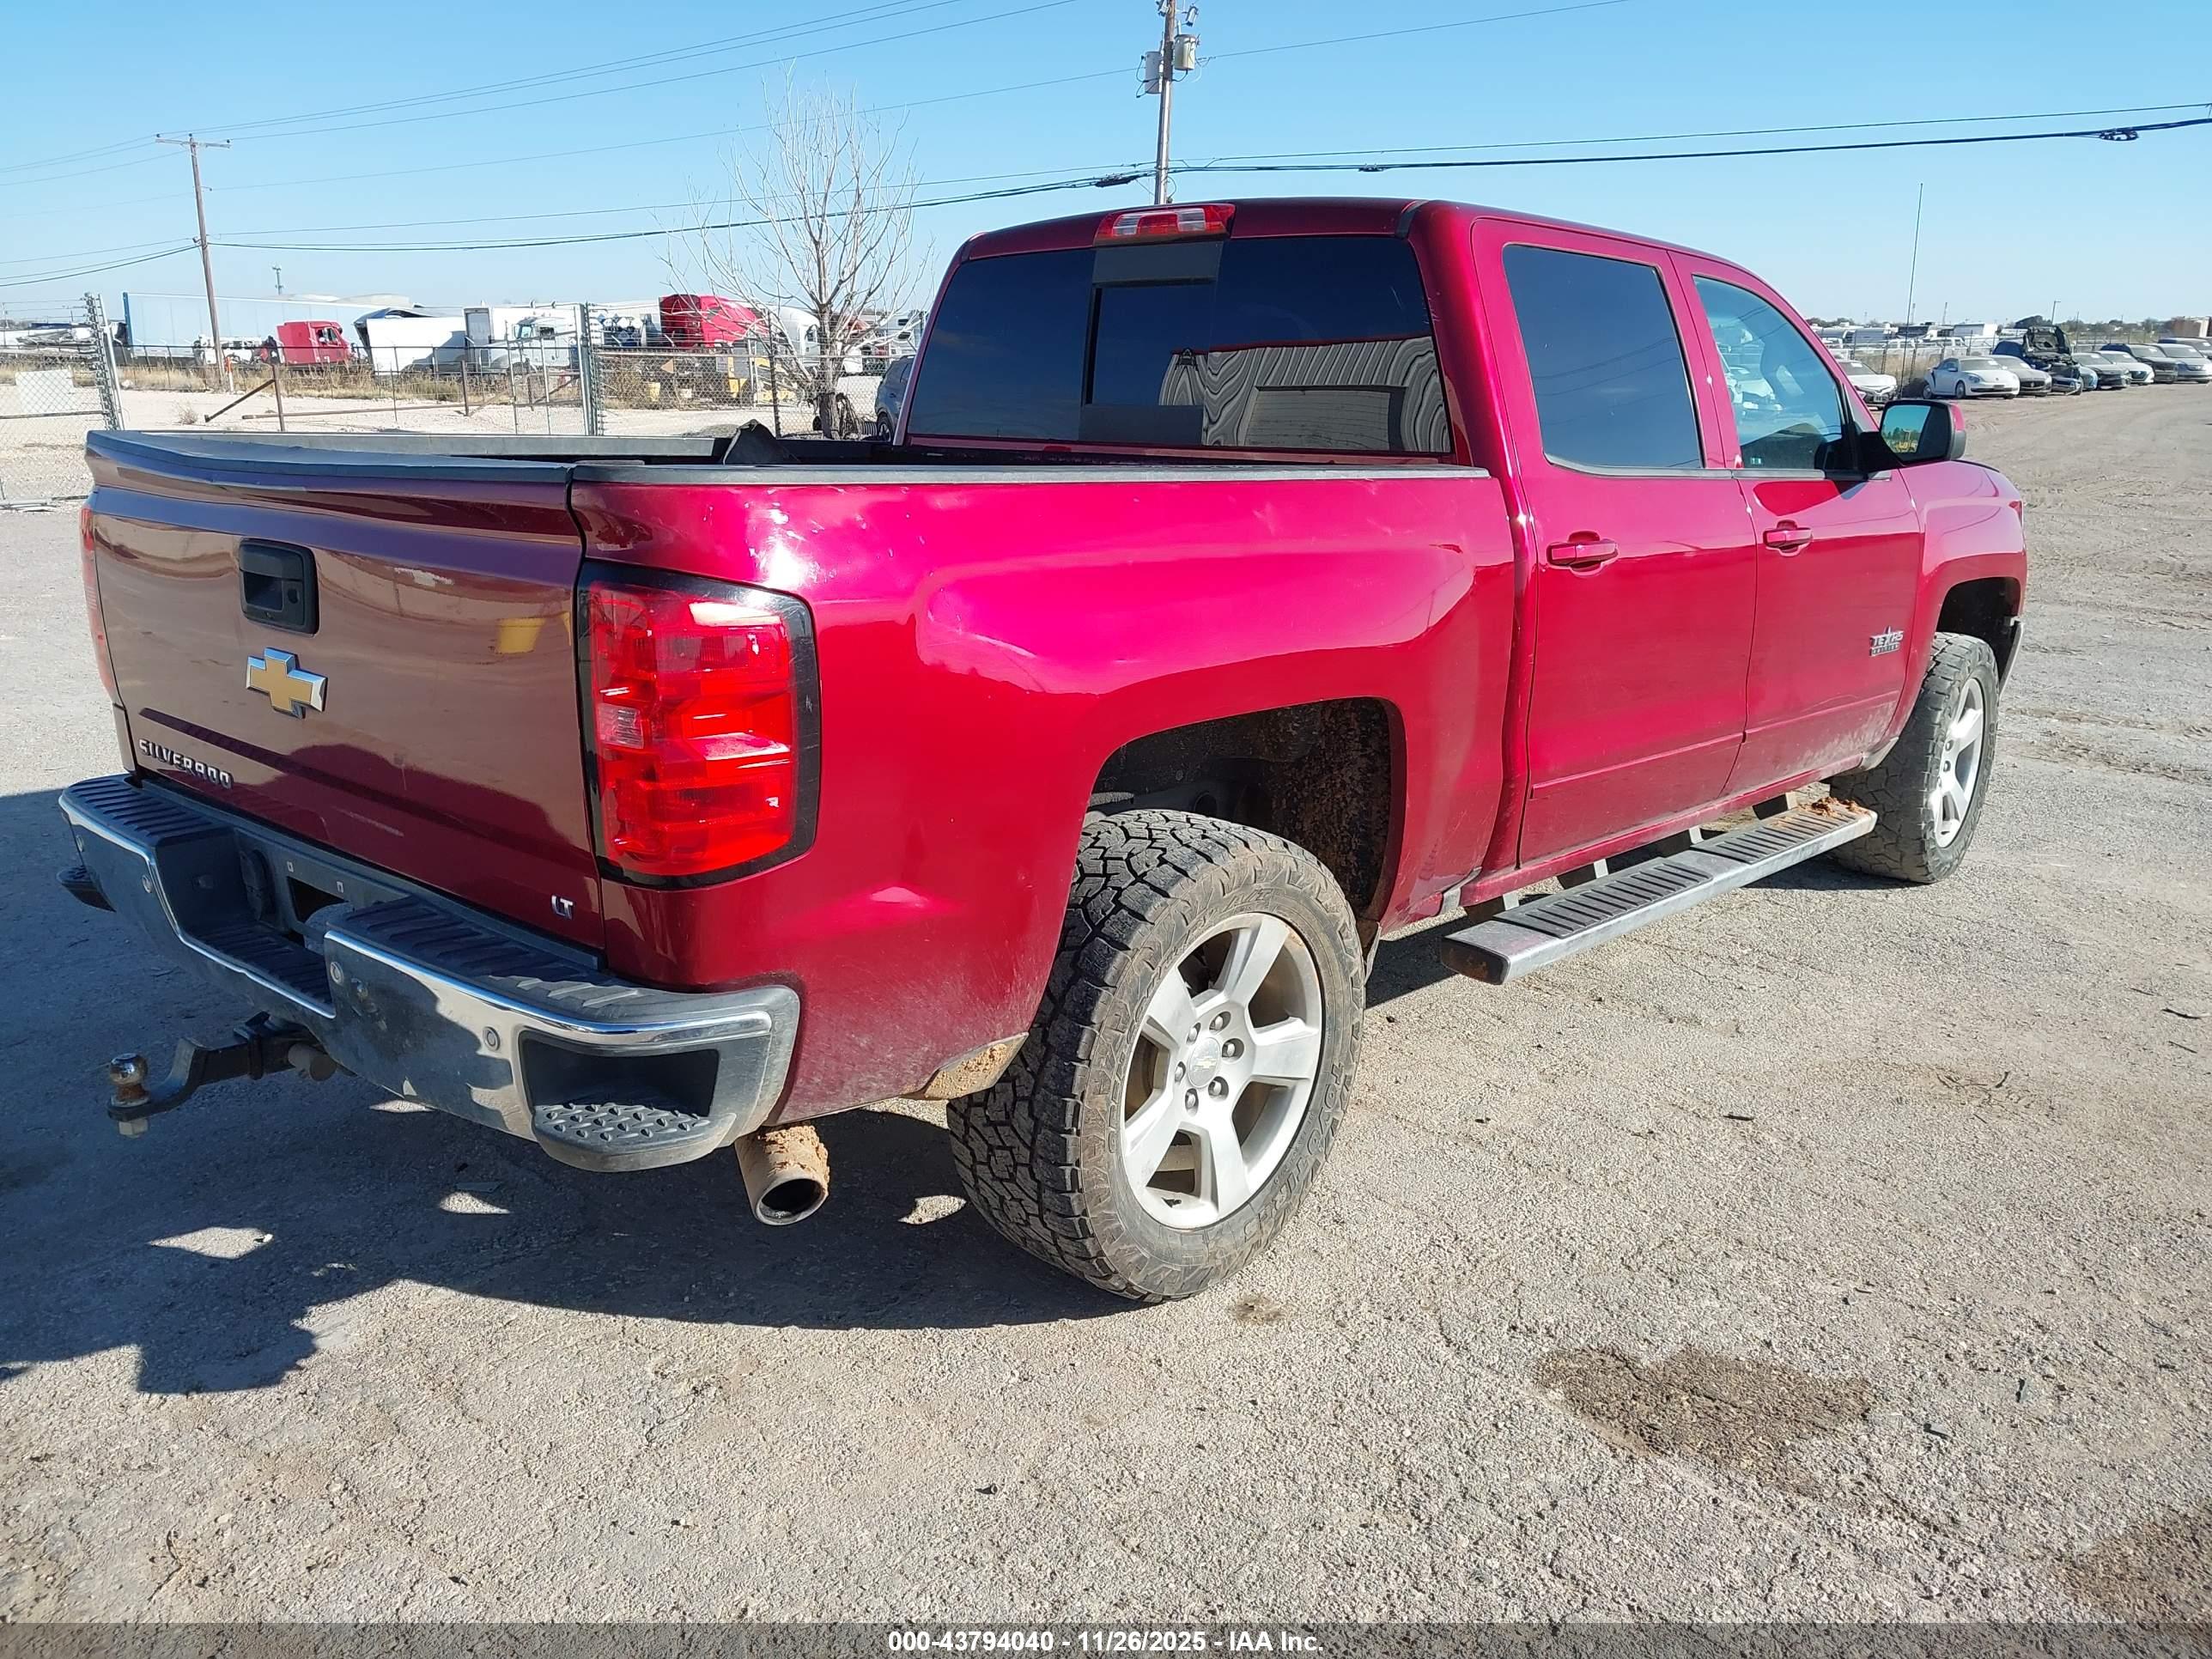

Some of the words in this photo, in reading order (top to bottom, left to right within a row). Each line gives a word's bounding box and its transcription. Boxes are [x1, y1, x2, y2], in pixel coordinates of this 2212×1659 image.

[1869, 630, 1904, 647] TEXAS
[137, 738, 234, 790] SILVERADO
[550, 894, 574, 921] LT
[1307, 1061, 1345, 1155] TOYO
[1243, 1156, 1310, 1242] TIRES
